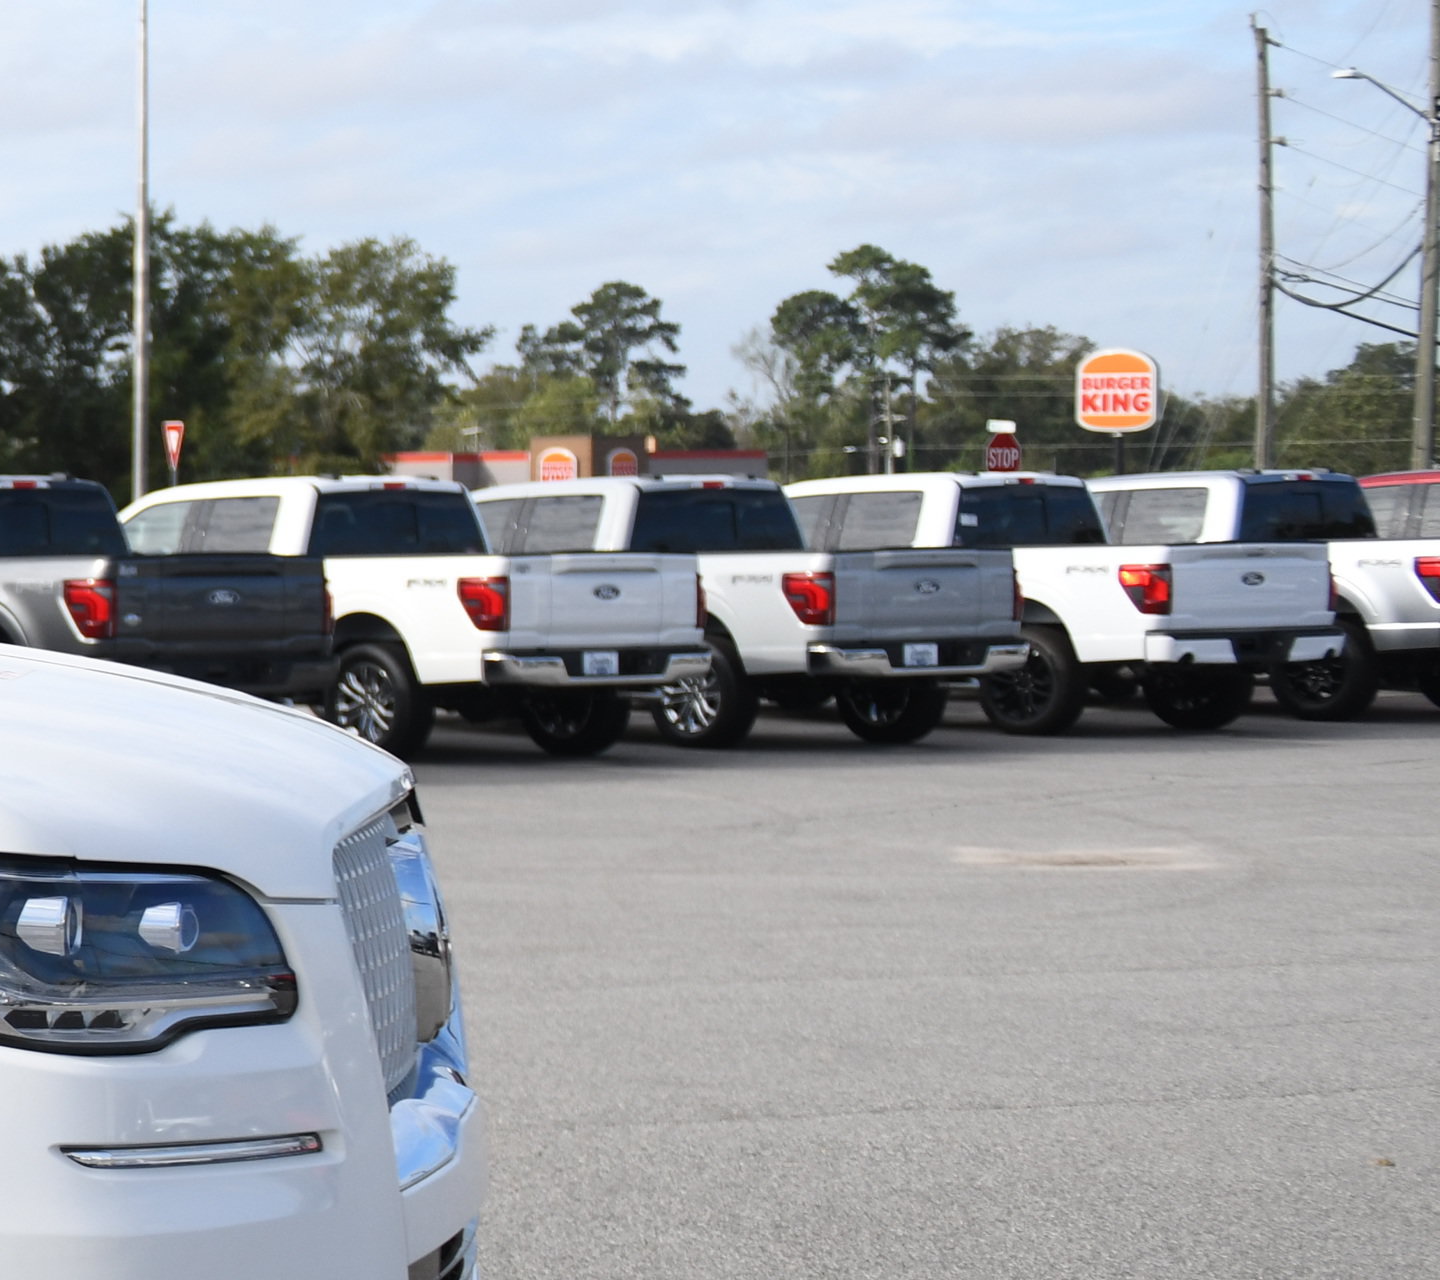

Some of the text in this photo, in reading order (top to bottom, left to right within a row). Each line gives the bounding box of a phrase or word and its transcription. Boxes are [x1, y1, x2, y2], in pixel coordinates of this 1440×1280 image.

[1082, 377, 1151, 390] BURGER
[1082, 393, 1151, 413] KING
[989, 448, 1019, 468] STOP
